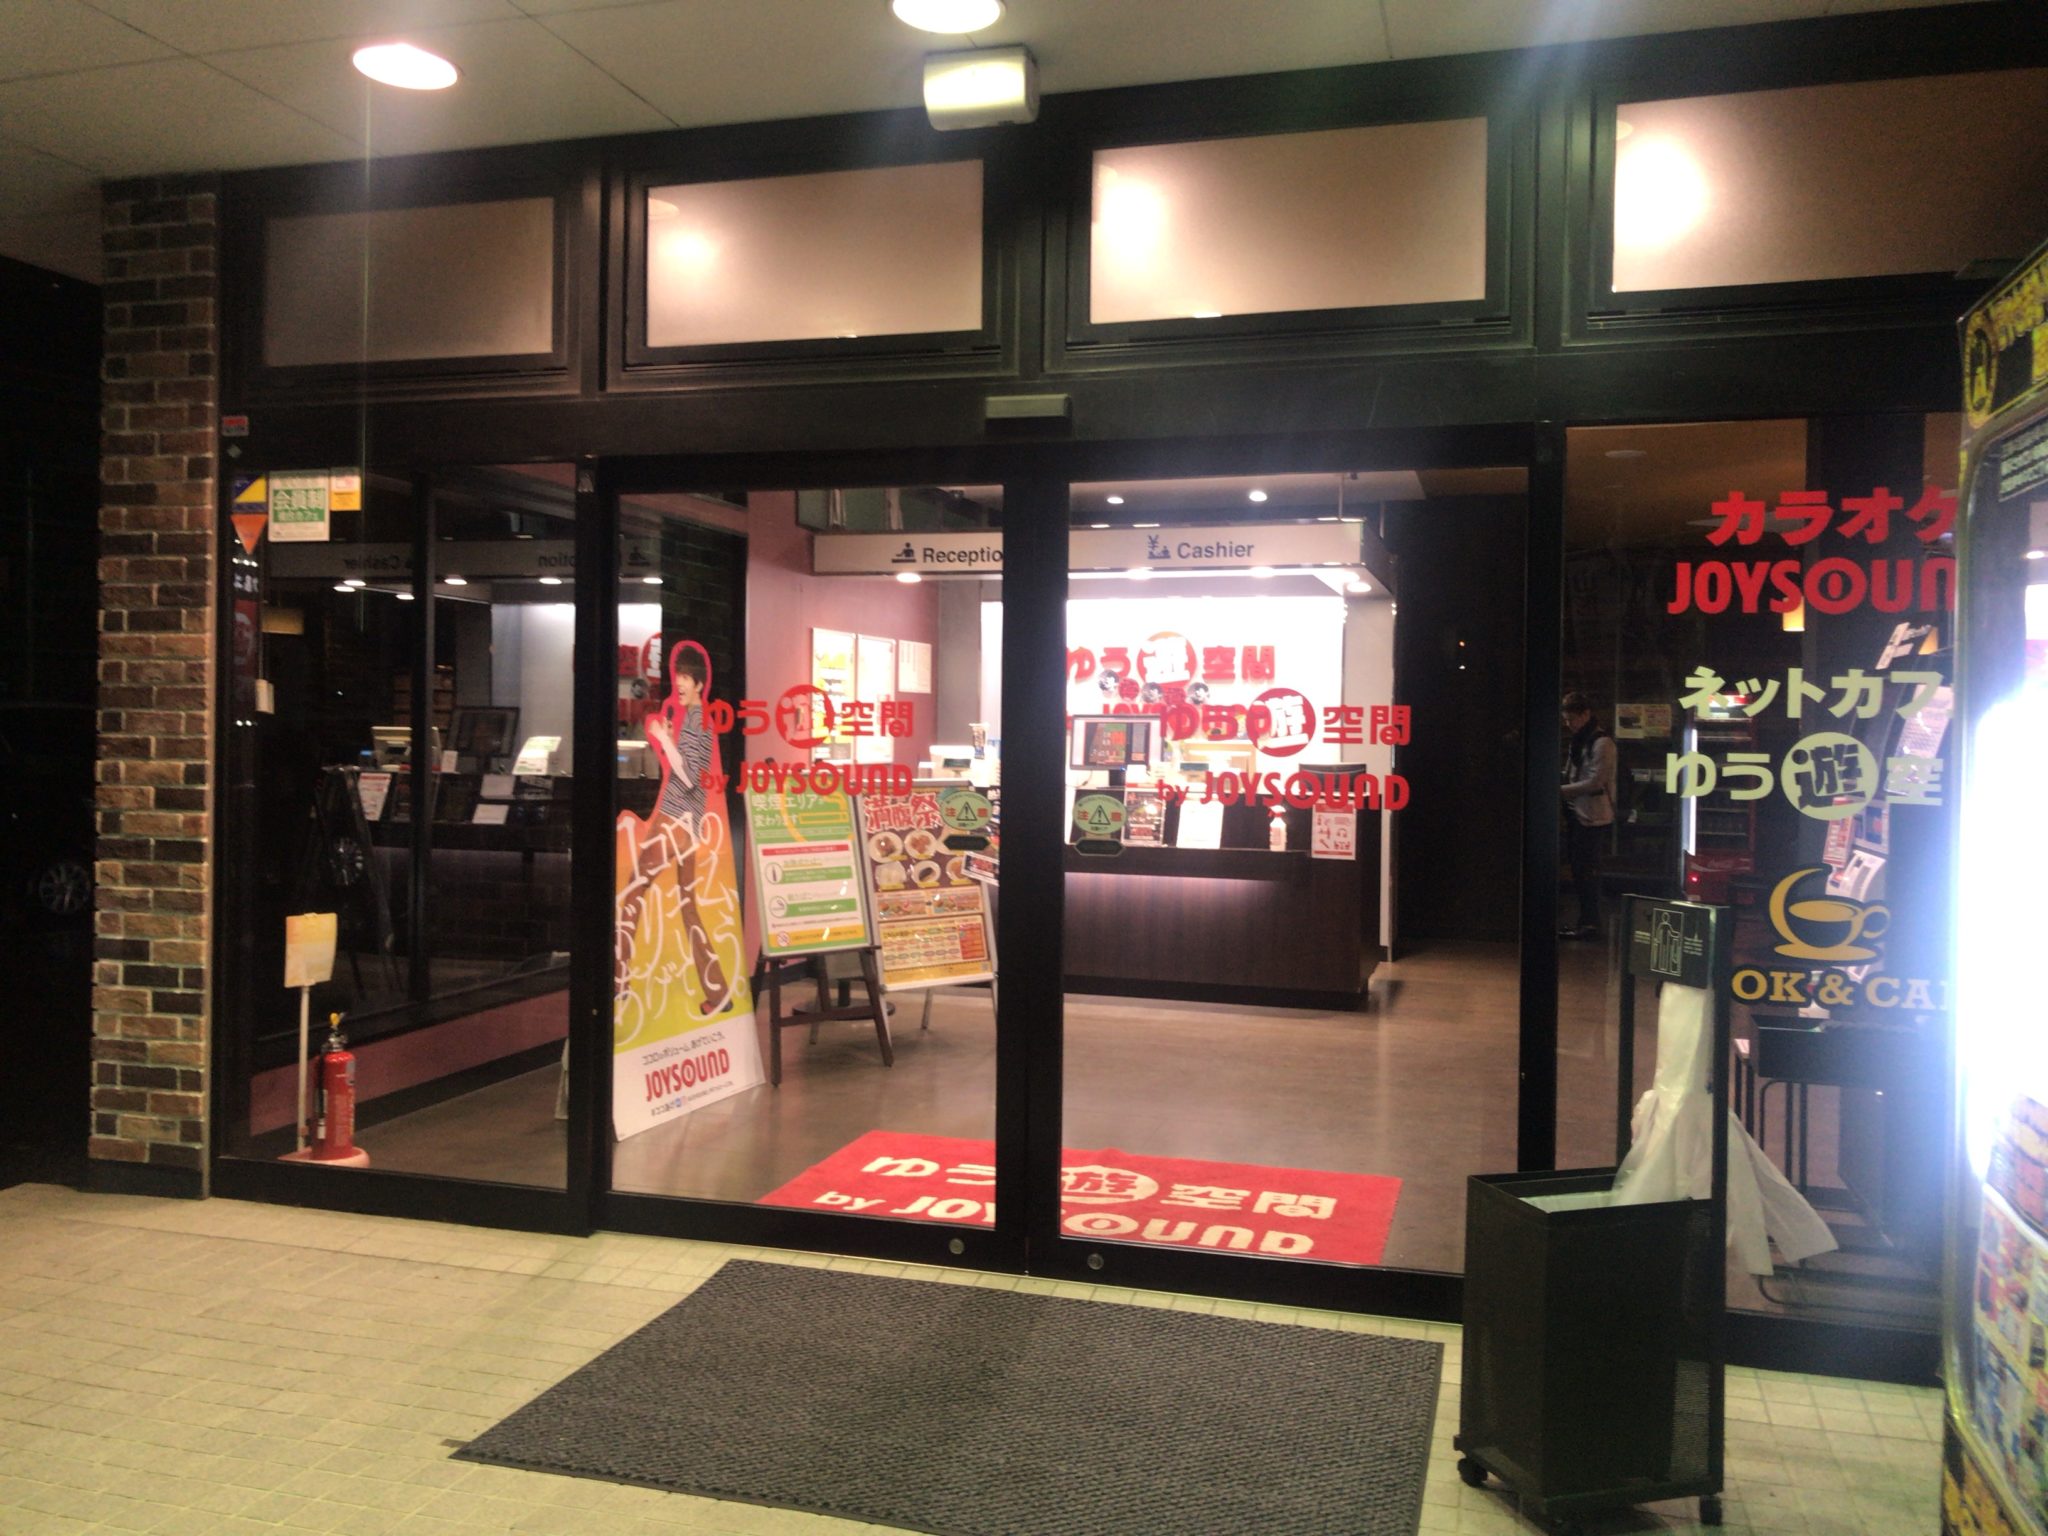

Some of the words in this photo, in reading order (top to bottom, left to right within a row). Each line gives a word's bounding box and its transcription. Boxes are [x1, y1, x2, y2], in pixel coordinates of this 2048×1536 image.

[922, 547, 1003, 567] Receptio
[1177, 542, 1254, 560] Cashier
[1667, 557, 1957, 614] JOYSOUN
[1679, 666, 1955, 719] ネットカフ
[736, 760, 914, 797] JOYSOUND
[1155, 778, 1190, 808] by
[1200, 770, 1411, 812] JOYSOUND
[1665, 732, 1944, 821] ゆう遊空
[1731, 969, 1807, 1003] OK
[1817, 973, 1854, 1006] &
[1865, 976, 1952, 1012] CA
[645, 1048, 730, 1102] JOYSOUND
[812, 1190, 886, 1211] by
[890, 1195, 1315, 1256] JOOUND
